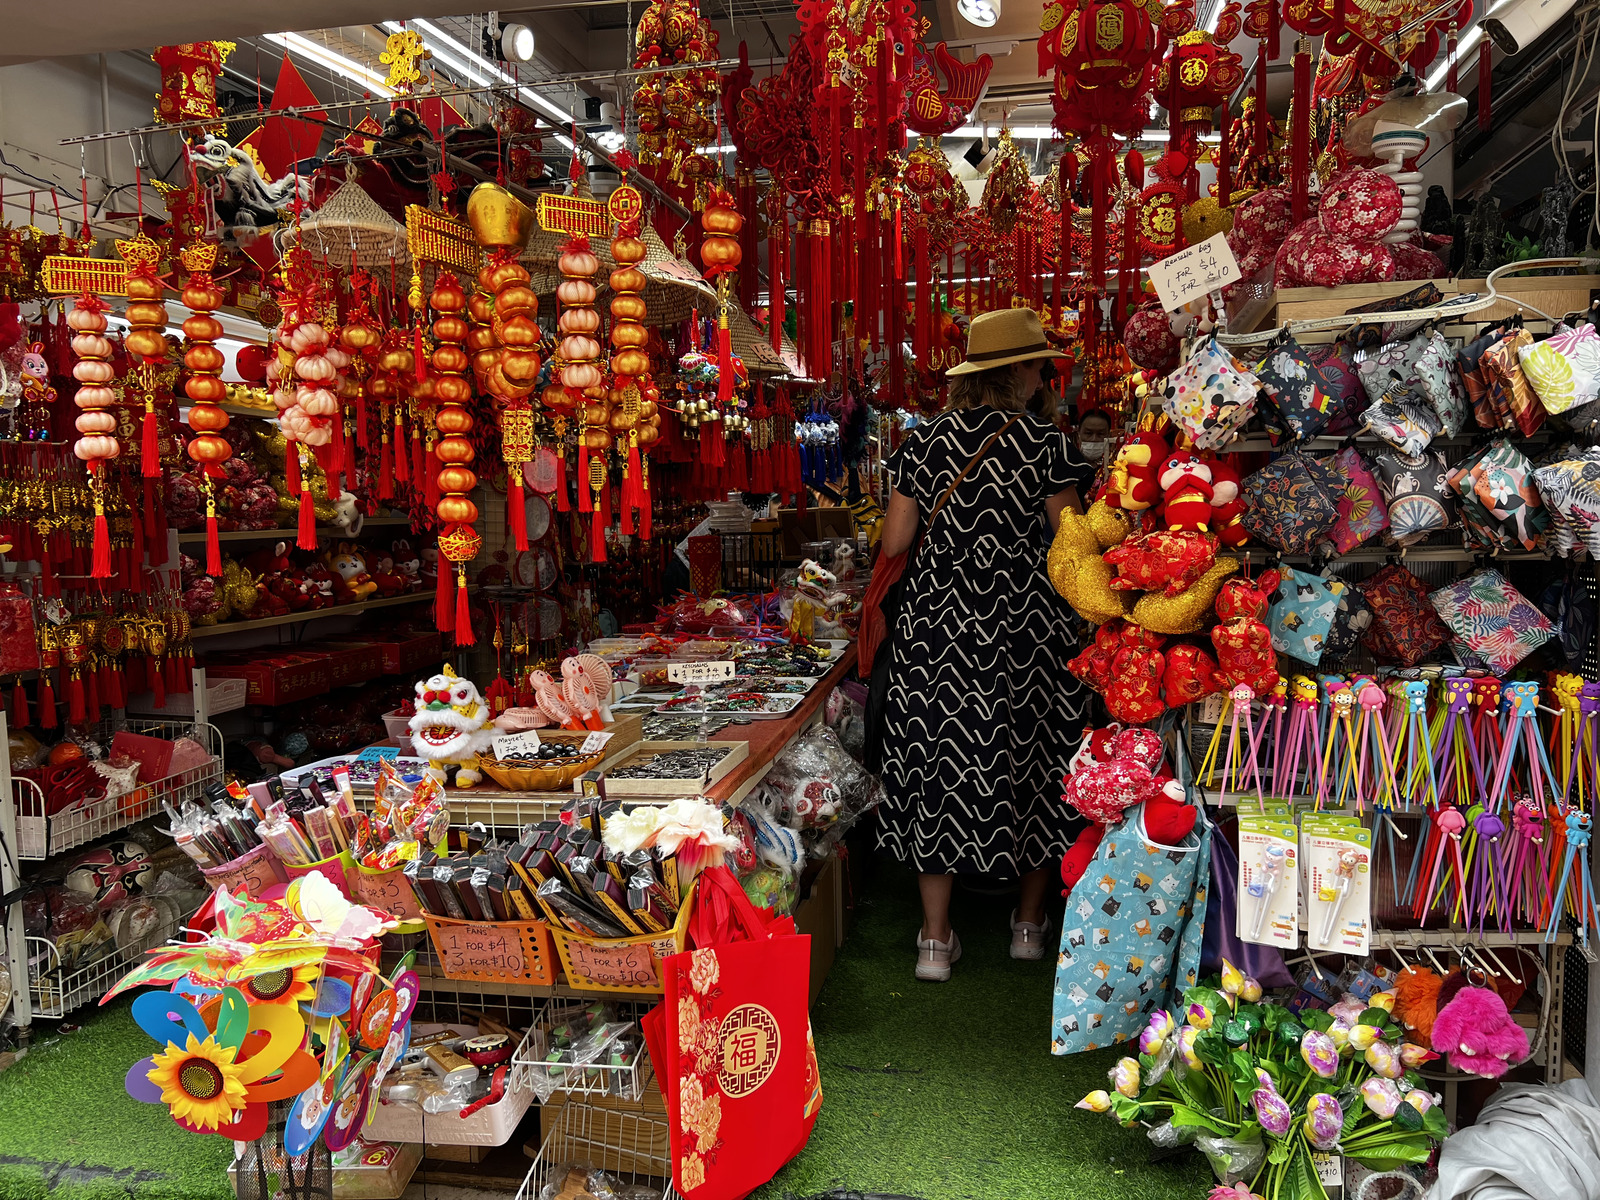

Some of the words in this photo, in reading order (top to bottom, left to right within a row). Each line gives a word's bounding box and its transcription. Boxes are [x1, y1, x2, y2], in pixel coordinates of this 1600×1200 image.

[1100, 18, 1120, 37] 福
[1183, 60, 1204, 82] 福
[916, 88, 943, 119] 福
[916, 166, 930, 183] 福
[1152, 207, 1176, 233] 福
[1198, 242, 1212, 254] bag
[1200, 256, 1217, 270] $4
[1171, 290, 1178, 301] 3
[1207, 265, 1229, 281] $10
[379, 880, 400, 898] $3
[466, 927, 488, 936] FANS
[450, 935, 461, 950] 1
[465, 942, 487, 952] FOR
[488, 936, 509, 953] $4
[452, 952, 465, 967] 3
[469, 958, 490, 966] FOR
[490, 954, 521, 971] $10
[577, 950, 588, 963] 1
[594, 958, 614, 968] FOR
[616, 952, 638, 968] $6
[580, 966, 594, 979] 2
[620, 970, 651, 982] $10
[731, 1031, 758, 1071] 福
